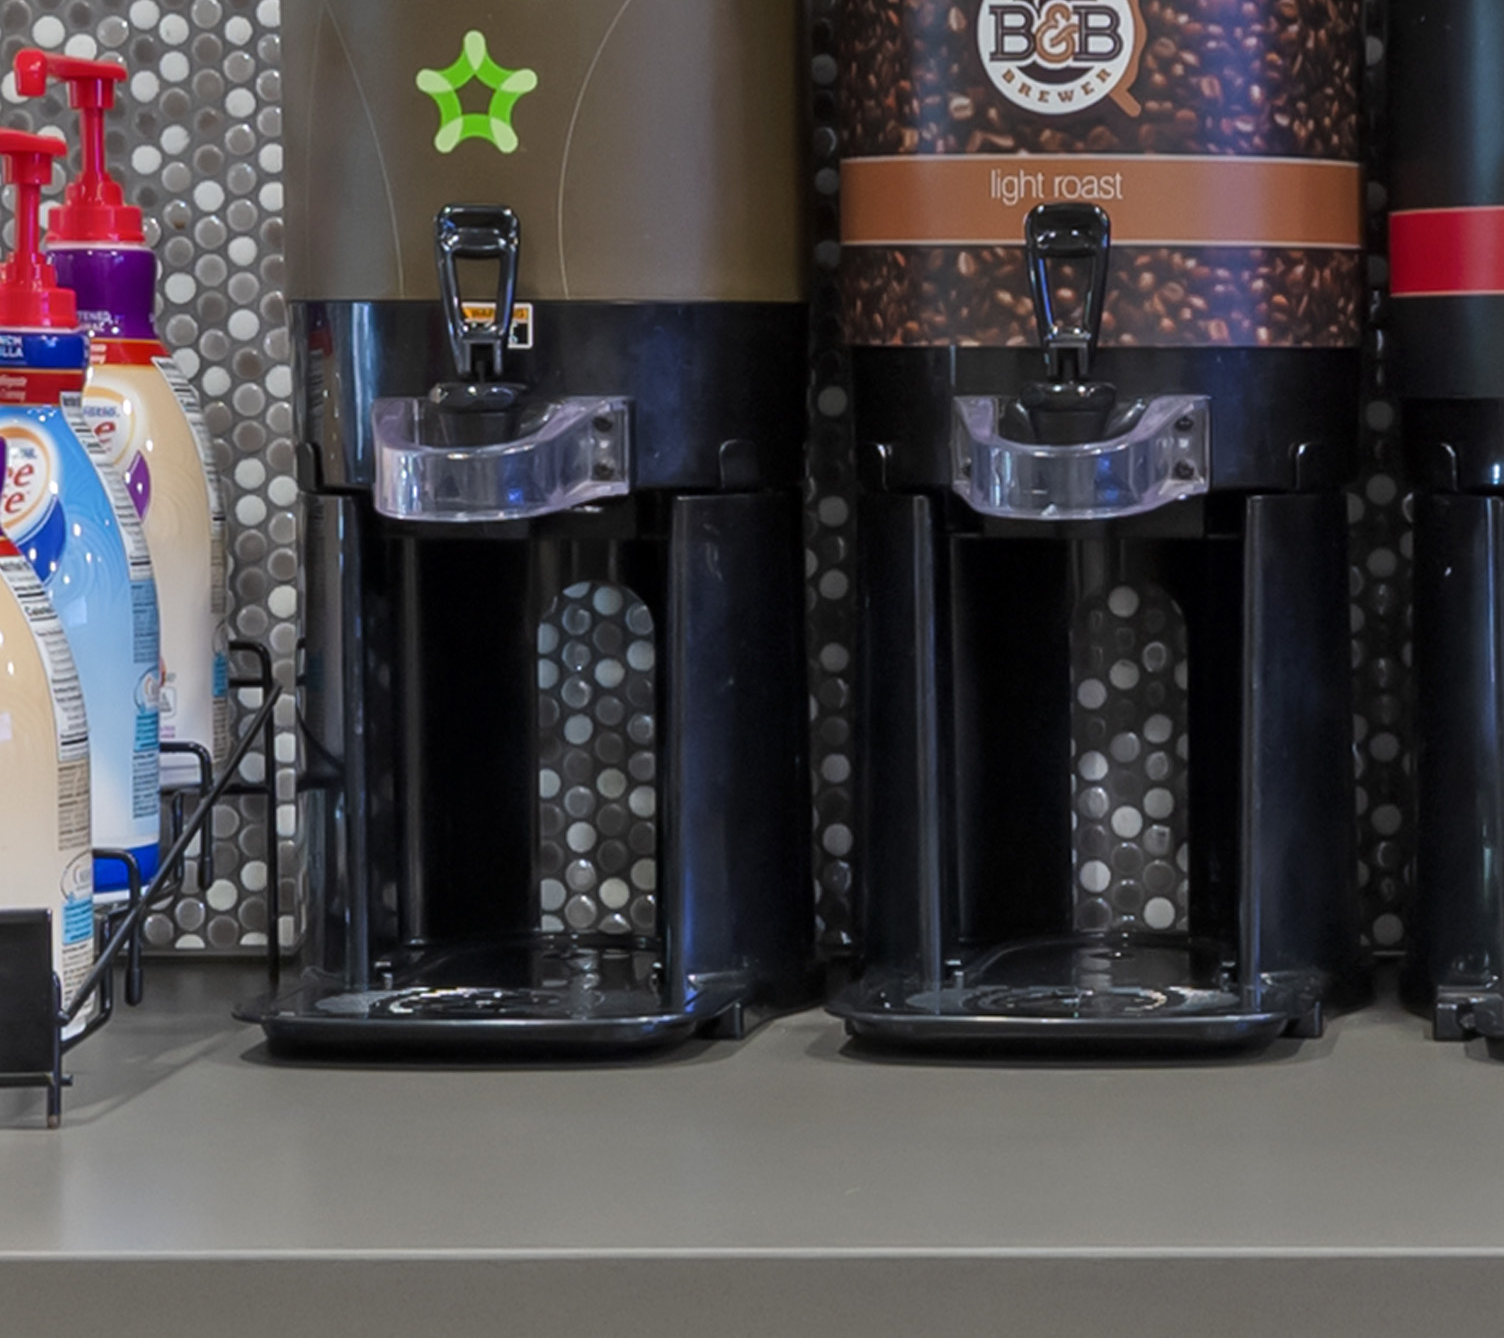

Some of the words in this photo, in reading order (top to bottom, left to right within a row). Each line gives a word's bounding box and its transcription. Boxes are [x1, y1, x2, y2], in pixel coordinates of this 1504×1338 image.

[989, 3, 1123, 63] B&B
[1002, 68, 1111, 103] BREWER
[990, 169, 1044, 206] light
[1054, 173, 1123, 199] roast
